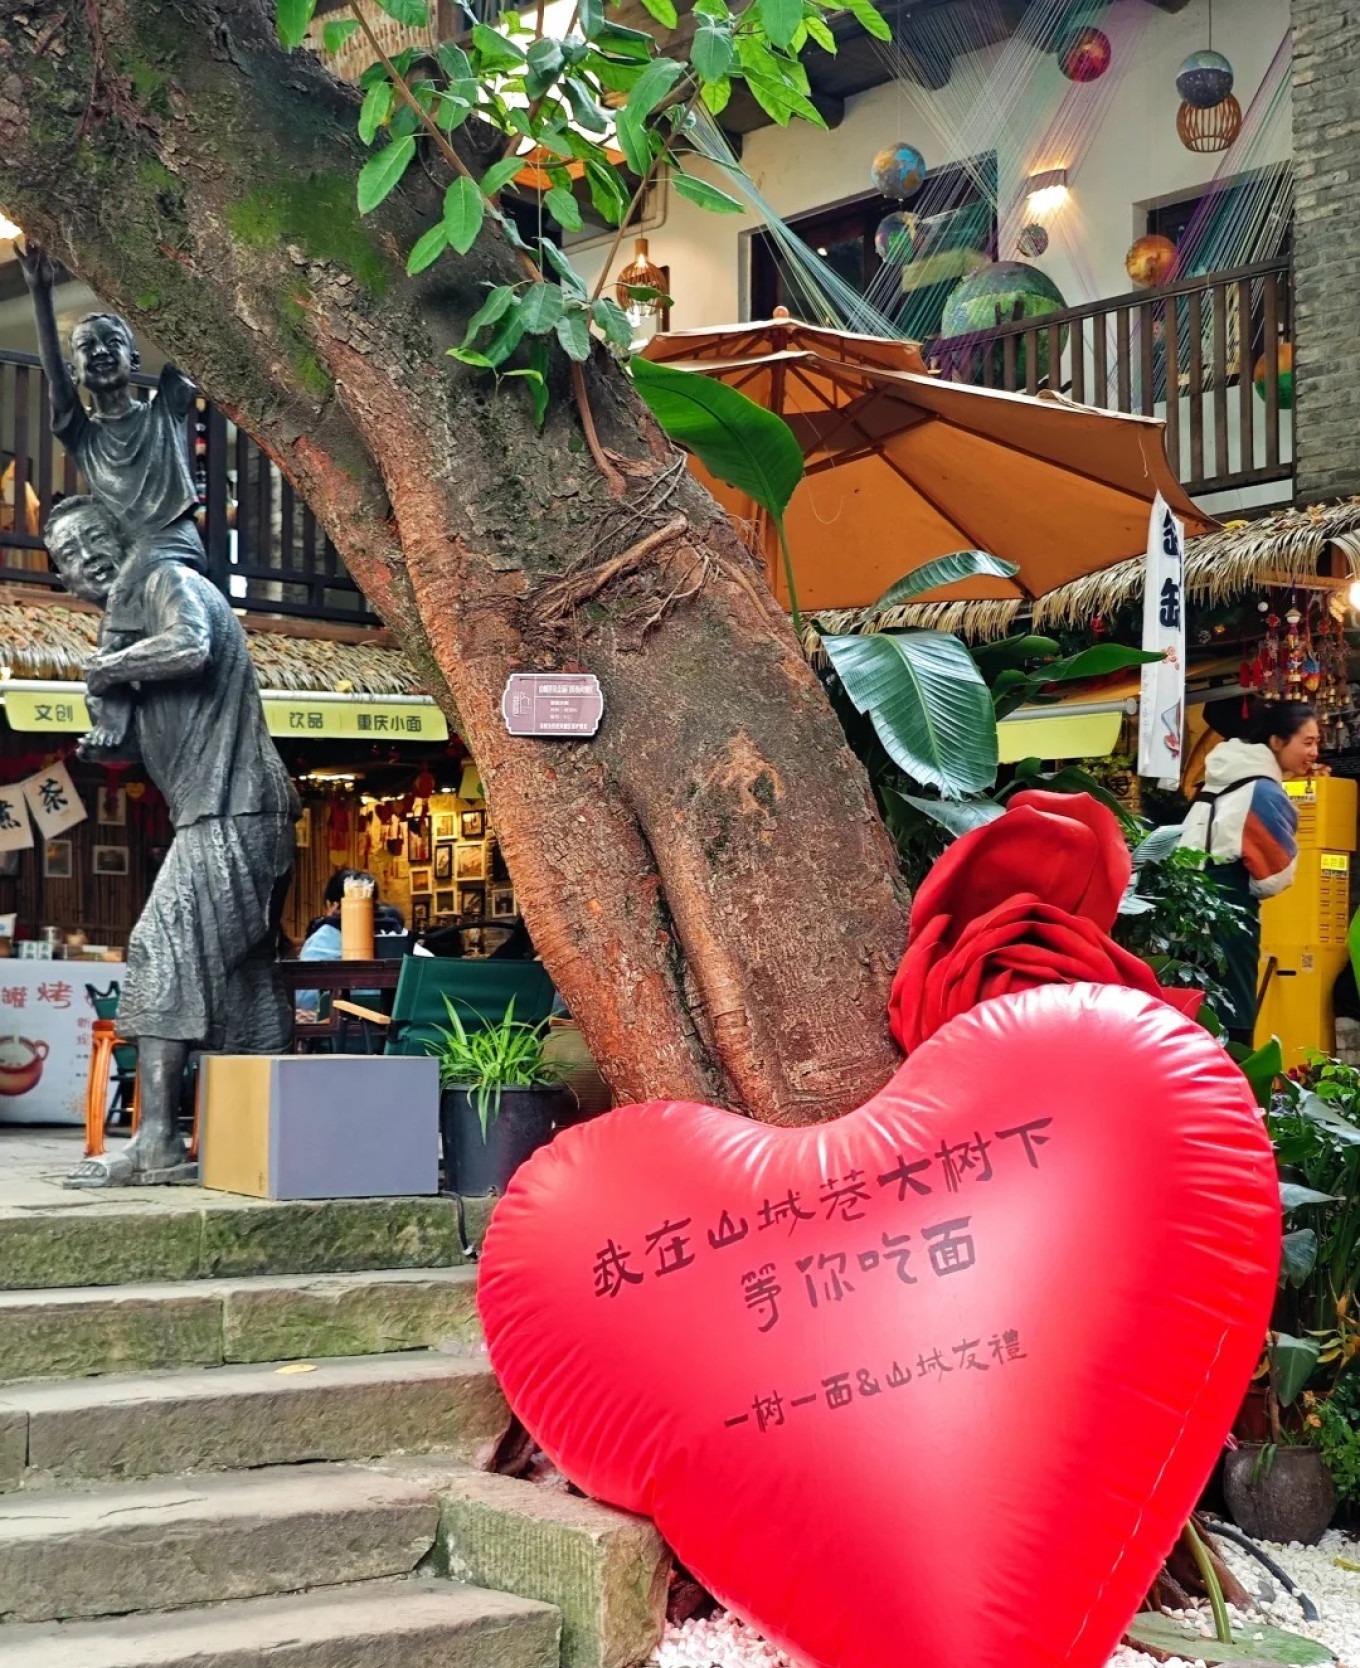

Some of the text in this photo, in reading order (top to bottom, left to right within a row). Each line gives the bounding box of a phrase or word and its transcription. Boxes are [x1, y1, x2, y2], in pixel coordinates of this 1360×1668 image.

[34, 704, 73, 721] 文创
[289, 712, 323, 729] 饮品
[357, 714, 422, 732] 重庆小面
[2, 981, 94, 1009] 罐烤
[741, 1215, 976, 1333] 等你吃面
